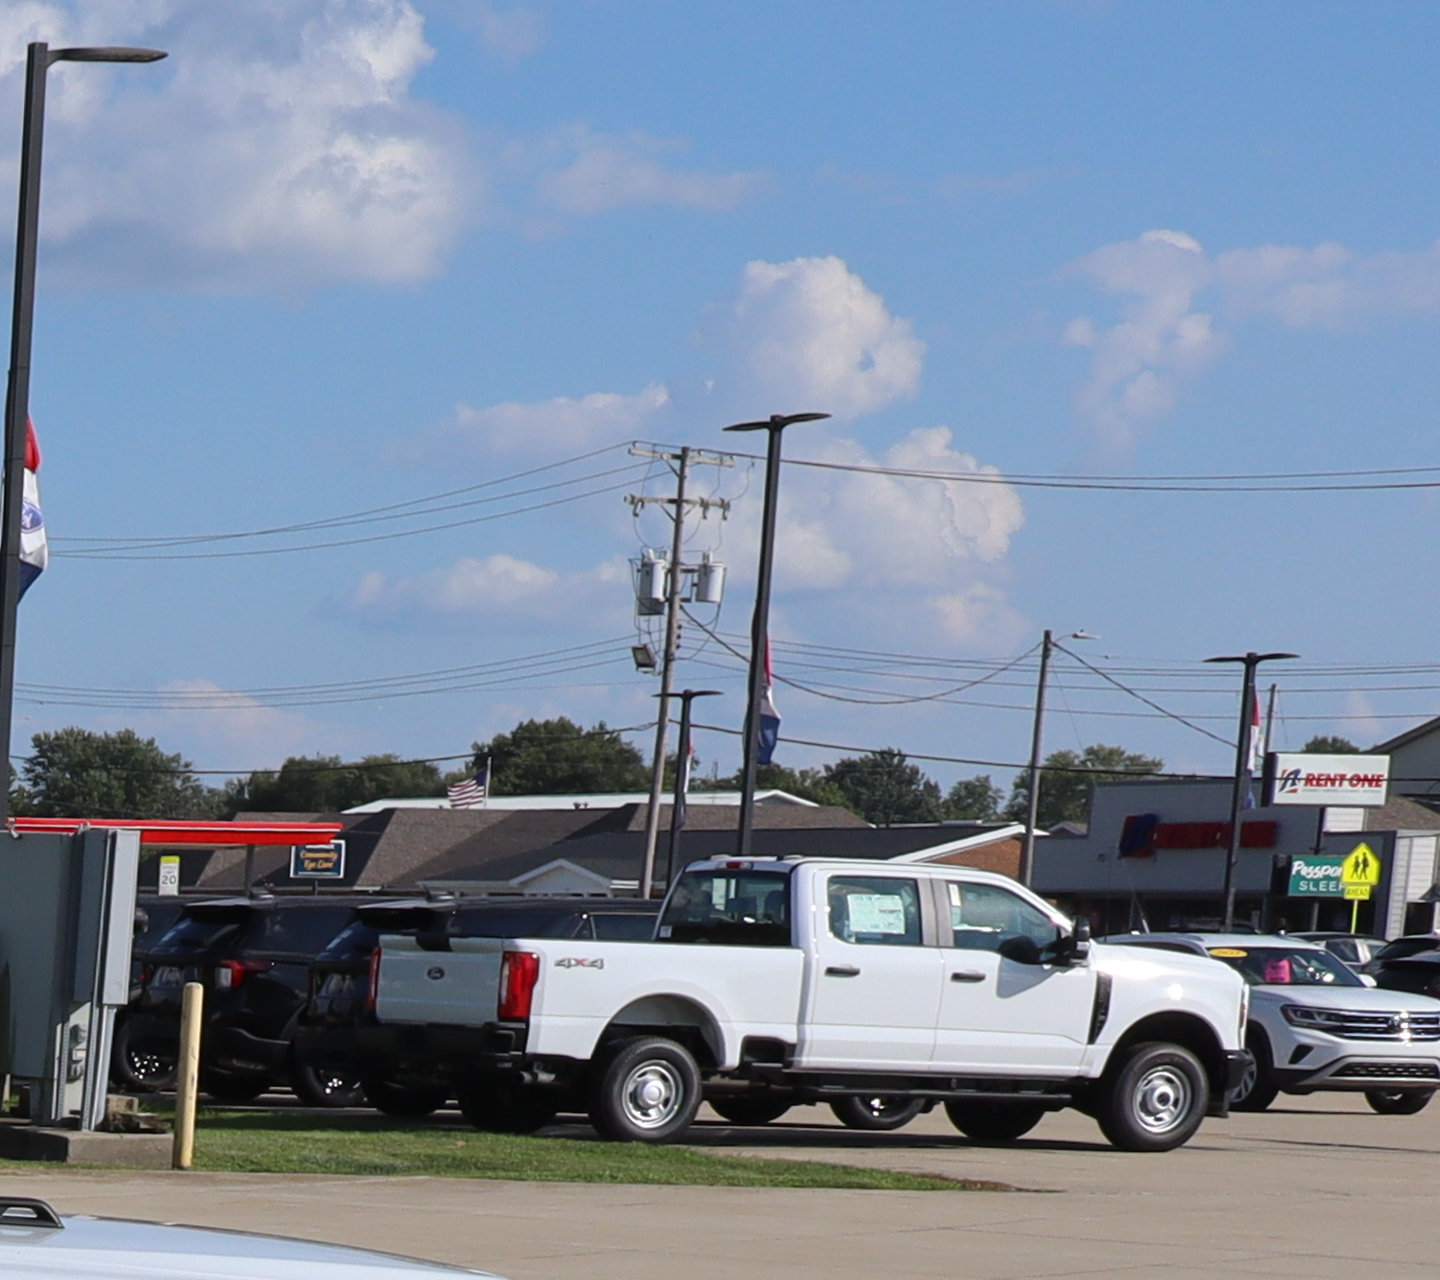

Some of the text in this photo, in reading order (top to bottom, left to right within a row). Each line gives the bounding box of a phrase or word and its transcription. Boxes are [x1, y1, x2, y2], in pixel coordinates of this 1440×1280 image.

[1304, 773, 1384, 788] RENT ONE
[162, 875, 177, 885] 20
